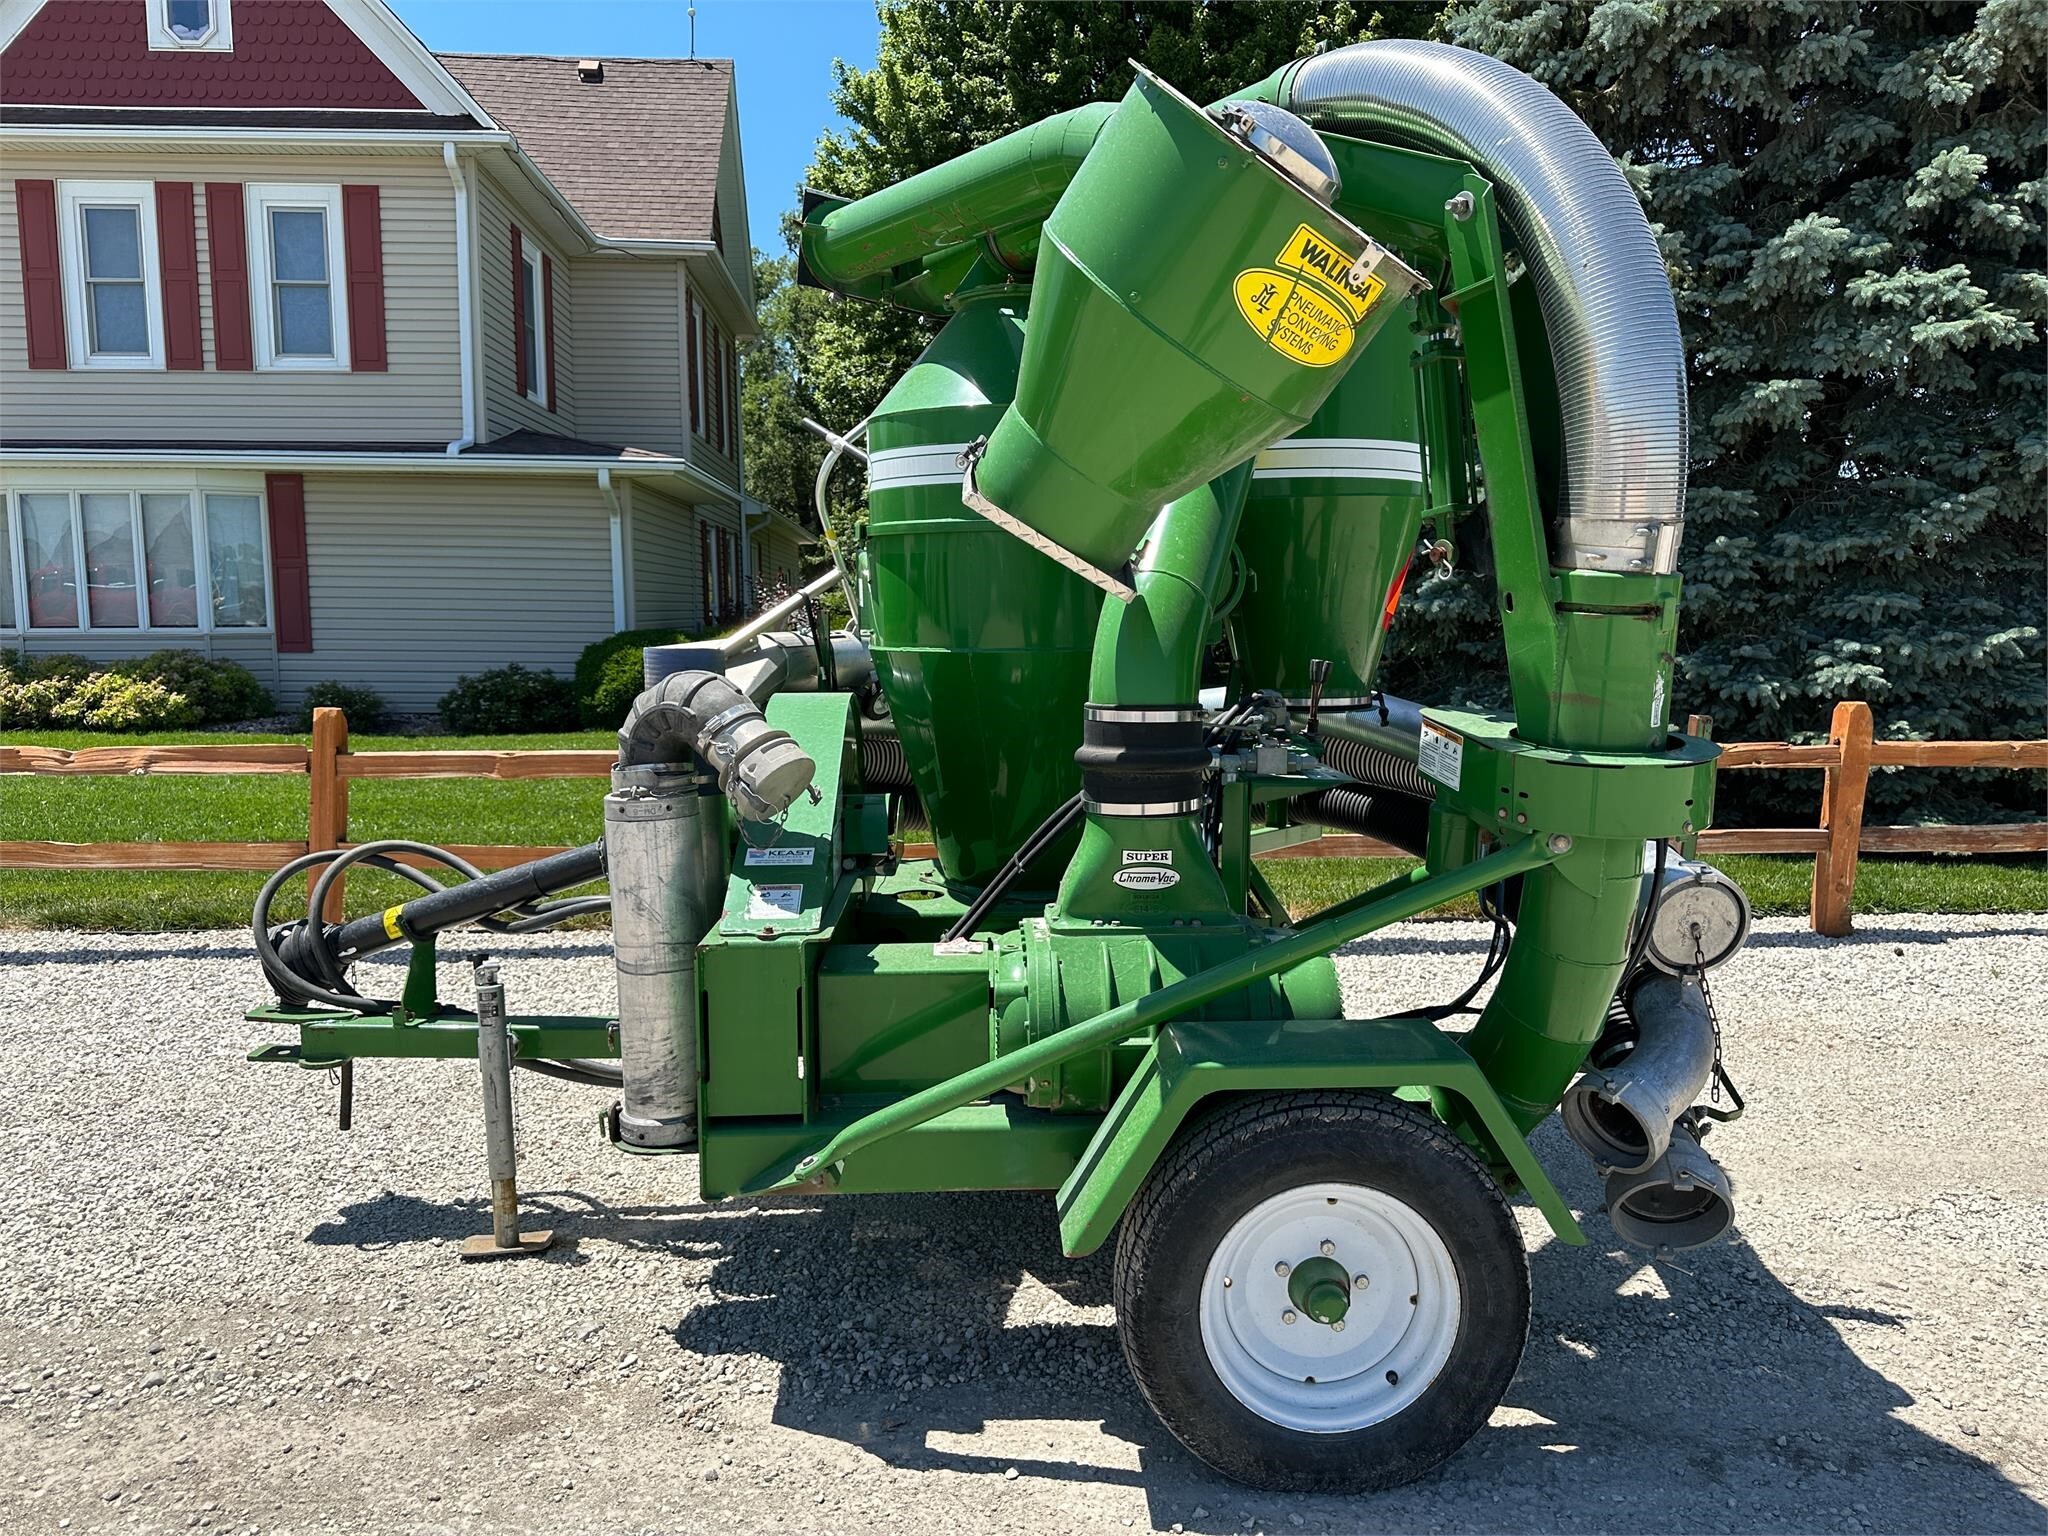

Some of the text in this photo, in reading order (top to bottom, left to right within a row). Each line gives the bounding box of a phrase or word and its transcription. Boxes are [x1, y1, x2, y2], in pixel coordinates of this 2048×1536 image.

[1299, 238, 1373, 303] WALINGA
[1279, 306, 1339, 351] CONVEYING
[1290, 290, 1347, 336] PNEUMATIC
[1267, 318, 1314, 355] SYSTEMS
[1118, 871, 1175, 883] Chrome-Vac
[1126, 852, 1169, 861] SUPER
